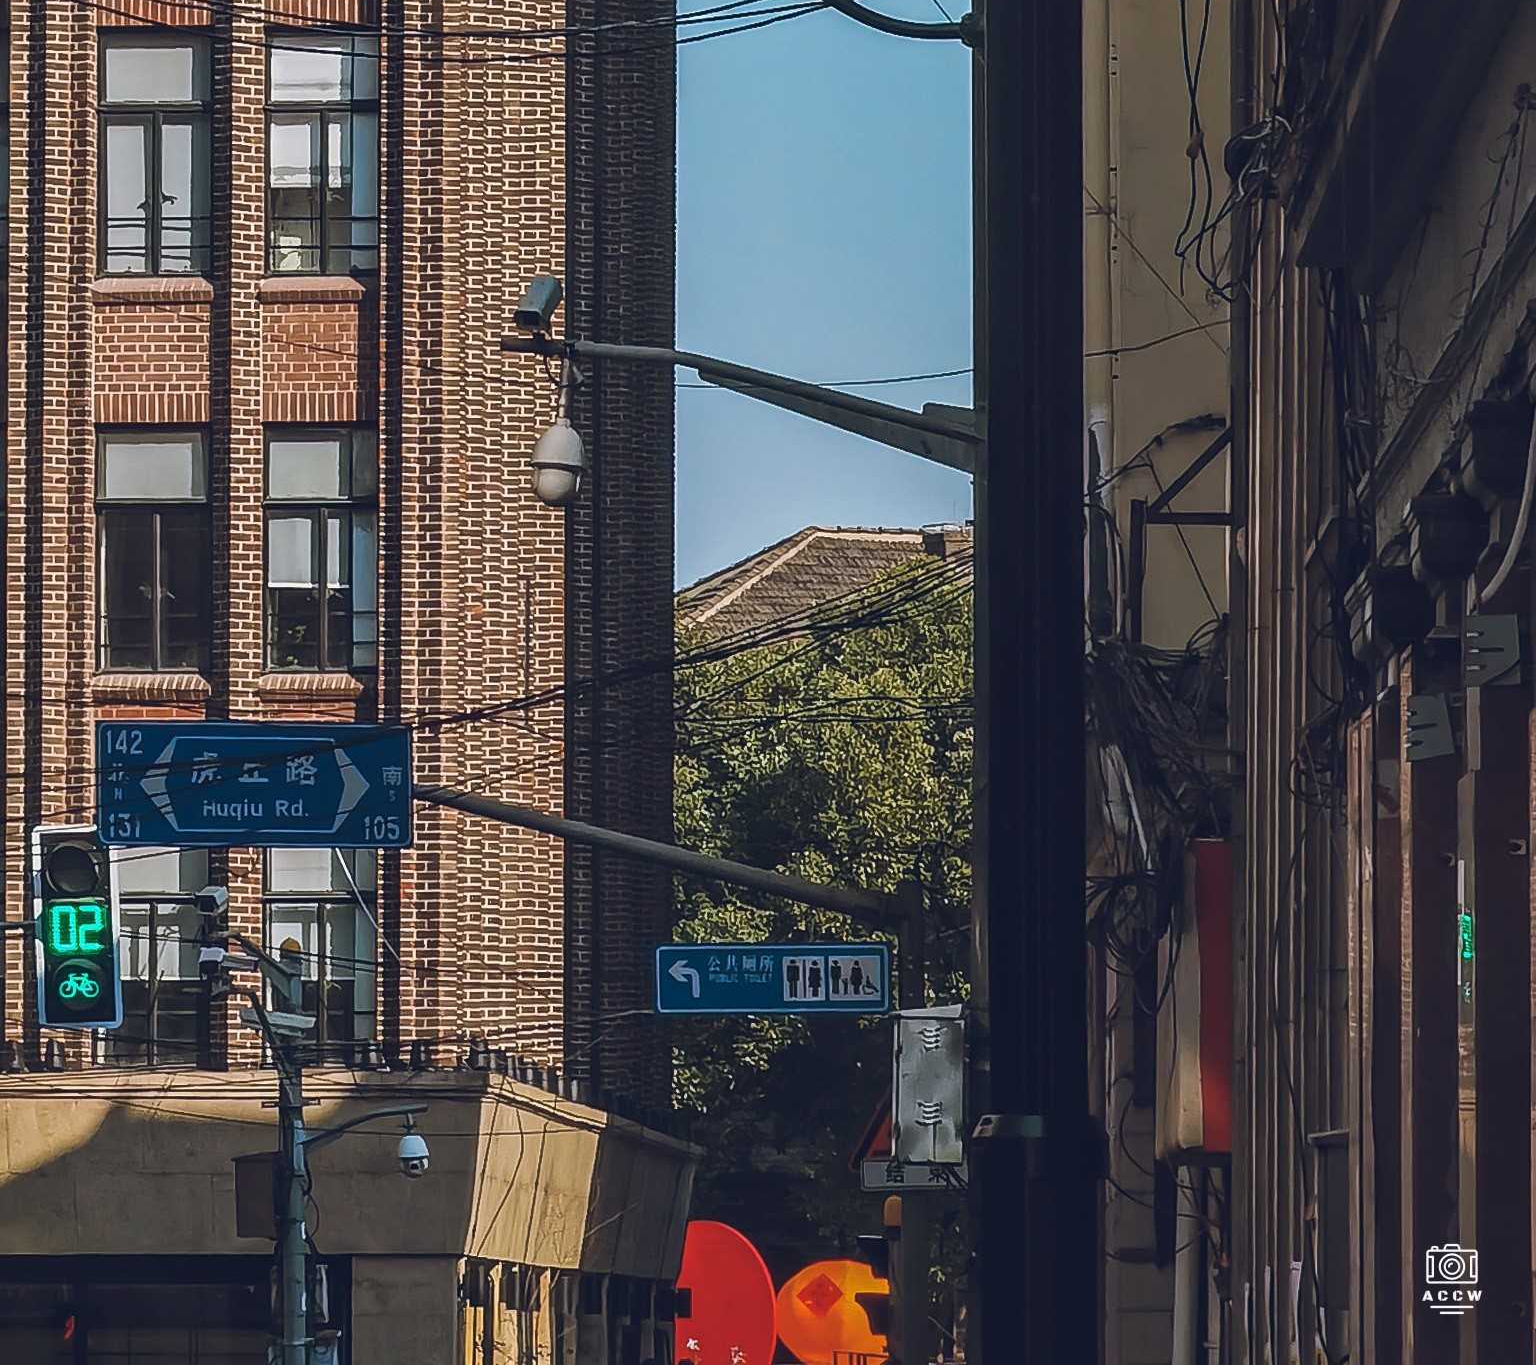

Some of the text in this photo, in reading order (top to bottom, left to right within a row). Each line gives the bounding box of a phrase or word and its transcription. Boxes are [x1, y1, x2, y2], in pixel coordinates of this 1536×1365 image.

[106, 729, 143, 755] 142
[382, 766, 403, 786] 南
[203, 798, 309, 821] Huqiu Rd.
[363, 815, 400, 840] 105
[49, 905, 105, 952] 02
